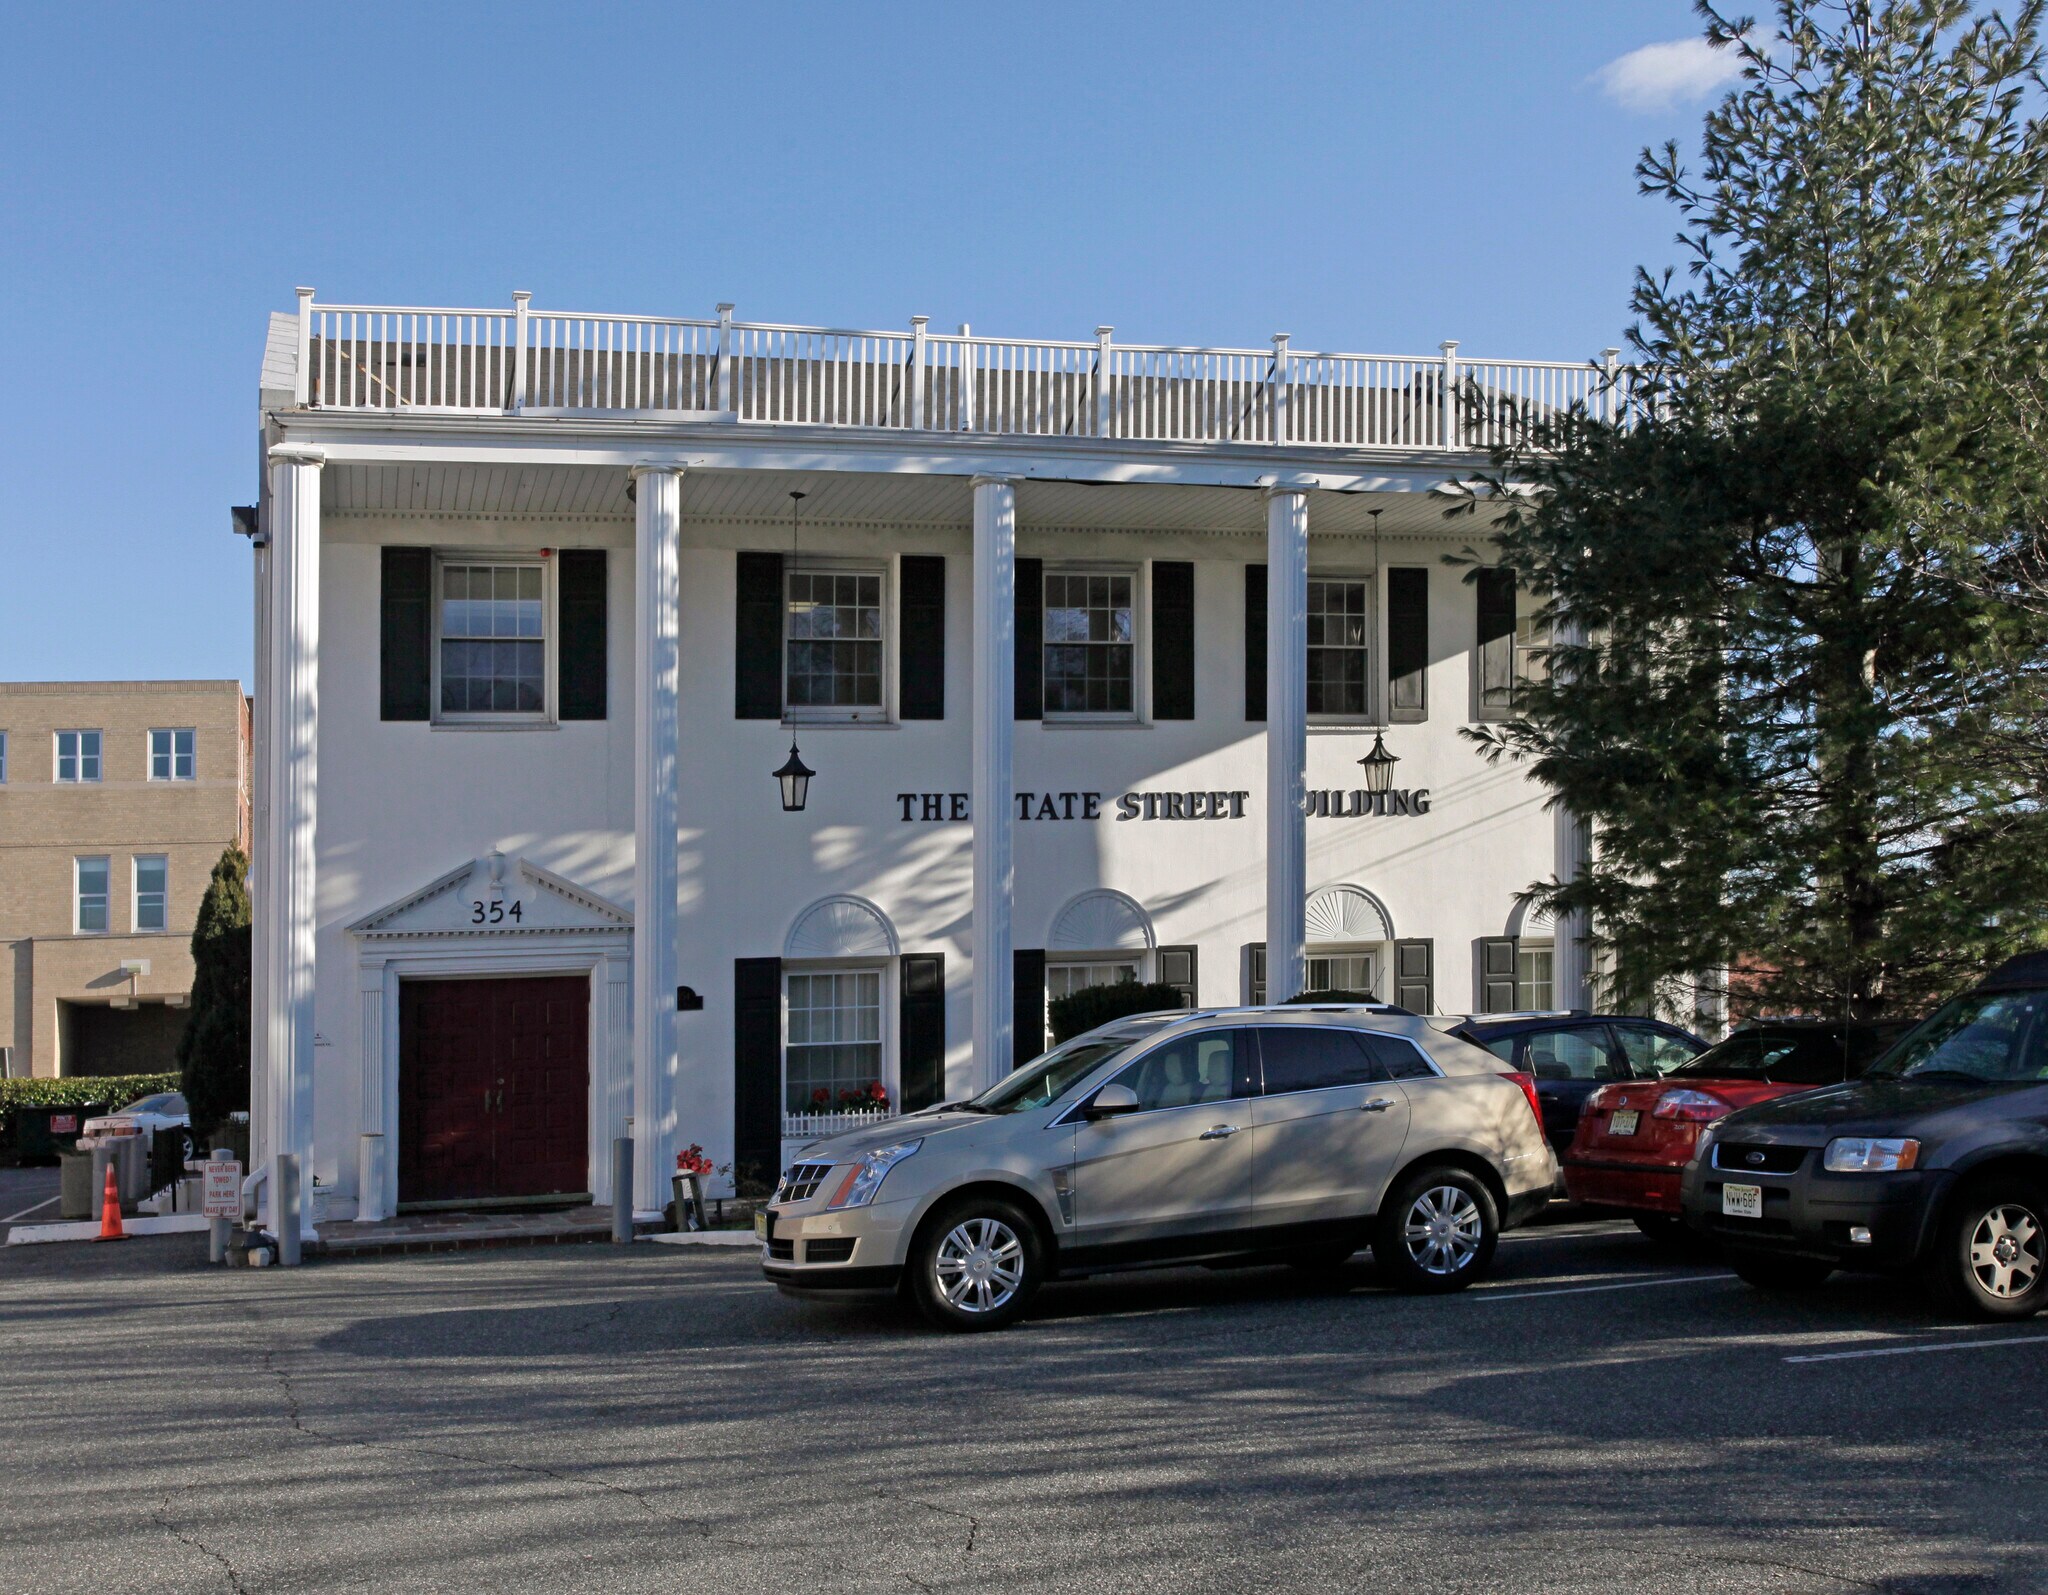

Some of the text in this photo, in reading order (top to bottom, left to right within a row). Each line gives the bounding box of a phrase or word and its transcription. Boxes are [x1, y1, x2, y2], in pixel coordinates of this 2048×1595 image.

[897, 788, 1431, 821] THE TATE STREET UILDING
[471, 900, 522, 924] 354
[225, 1165, 237, 1173] BEEN
[209, 1190, 235, 1198] PARK HERE
[205, 1206, 219, 1214] MAKE
